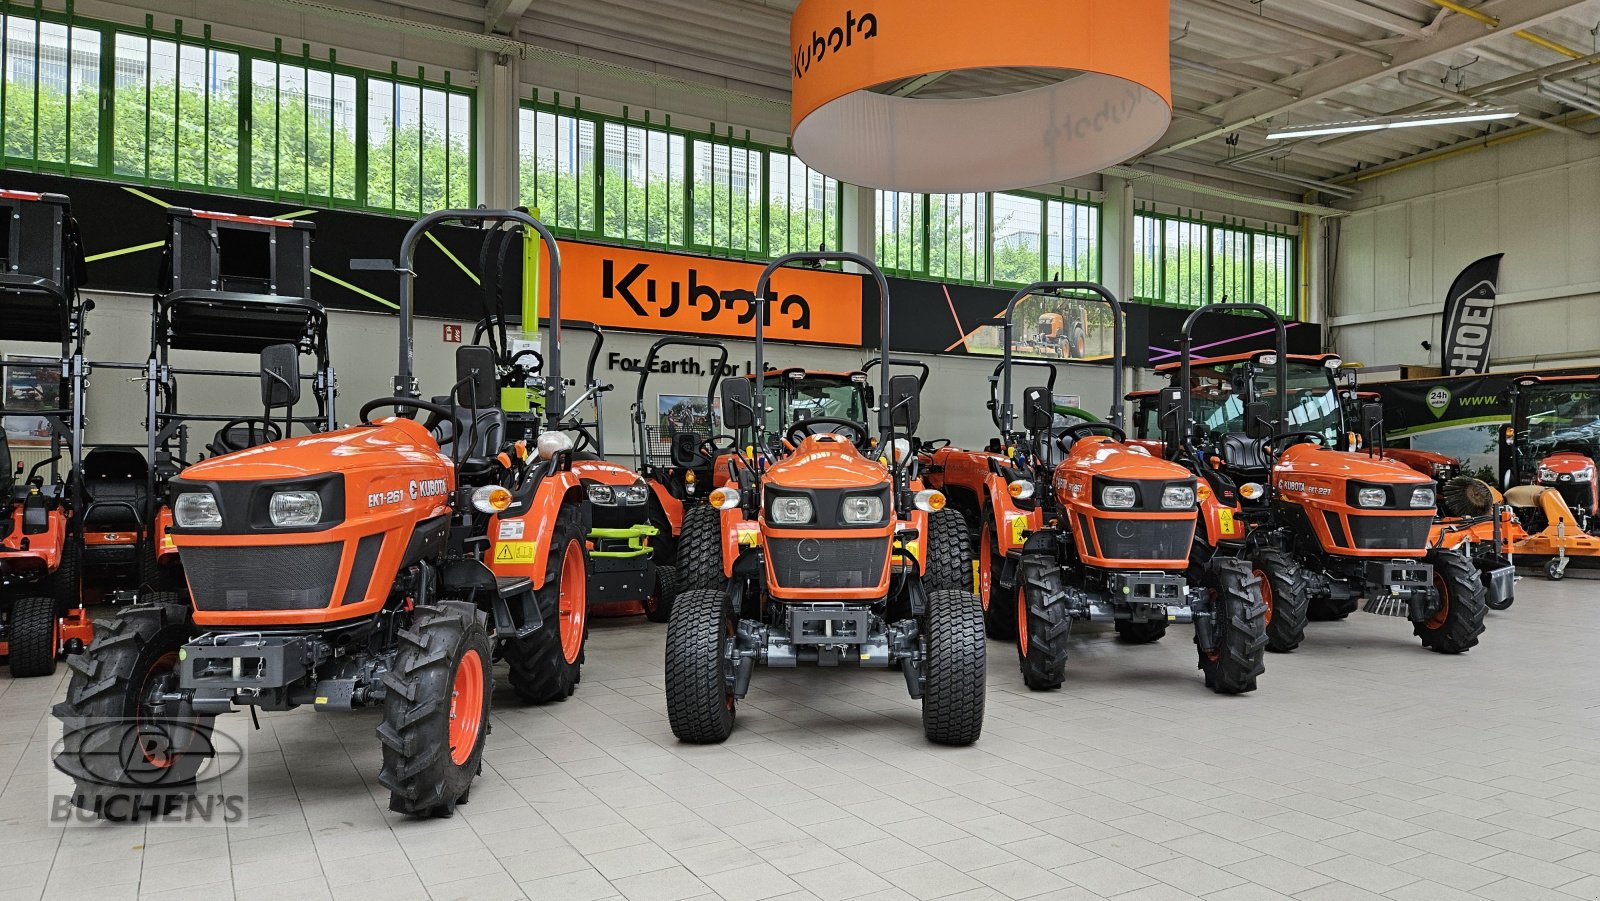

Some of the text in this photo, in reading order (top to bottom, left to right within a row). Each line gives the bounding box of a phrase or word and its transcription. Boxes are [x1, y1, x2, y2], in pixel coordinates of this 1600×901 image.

[794, 9, 877, 79] Kubota
[602, 259, 811, 330] Kubota
[608, 352, 641, 371] For
[650, 355, 706, 377] Earth,
[711, 358, 740, 378] For
[1430, 391, 1447, 400] 24h
[368, 478, 447, 508] EK1-261 KUBOTA
[1284, 480, 1305, 492] KUBOTA
